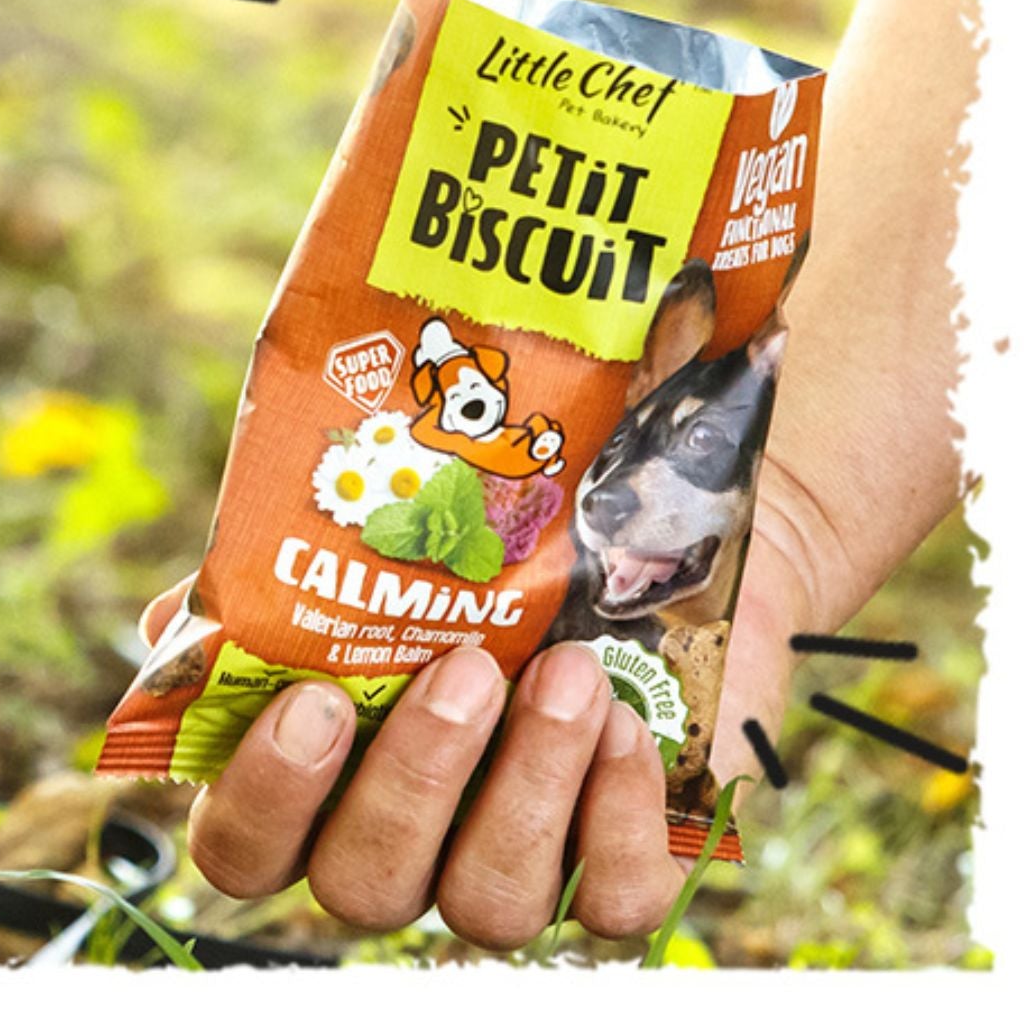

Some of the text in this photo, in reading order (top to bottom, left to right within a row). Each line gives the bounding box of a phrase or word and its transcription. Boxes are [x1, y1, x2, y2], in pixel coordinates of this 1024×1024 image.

[476, 36, 678, 125] Little Chef
[558, 97, 648, 139] Pet Bakery
[729, 133, 808, 217] Vegan
[333, 342, 393, 378] SUPER
[343, 366, 392, 399] FOOD
[291, 601, 487, 646] Valerian root, Chamomile
[327, 643, 434, 665] & Lemon Balm
[602, 645, 678, 720] Gluten Free
